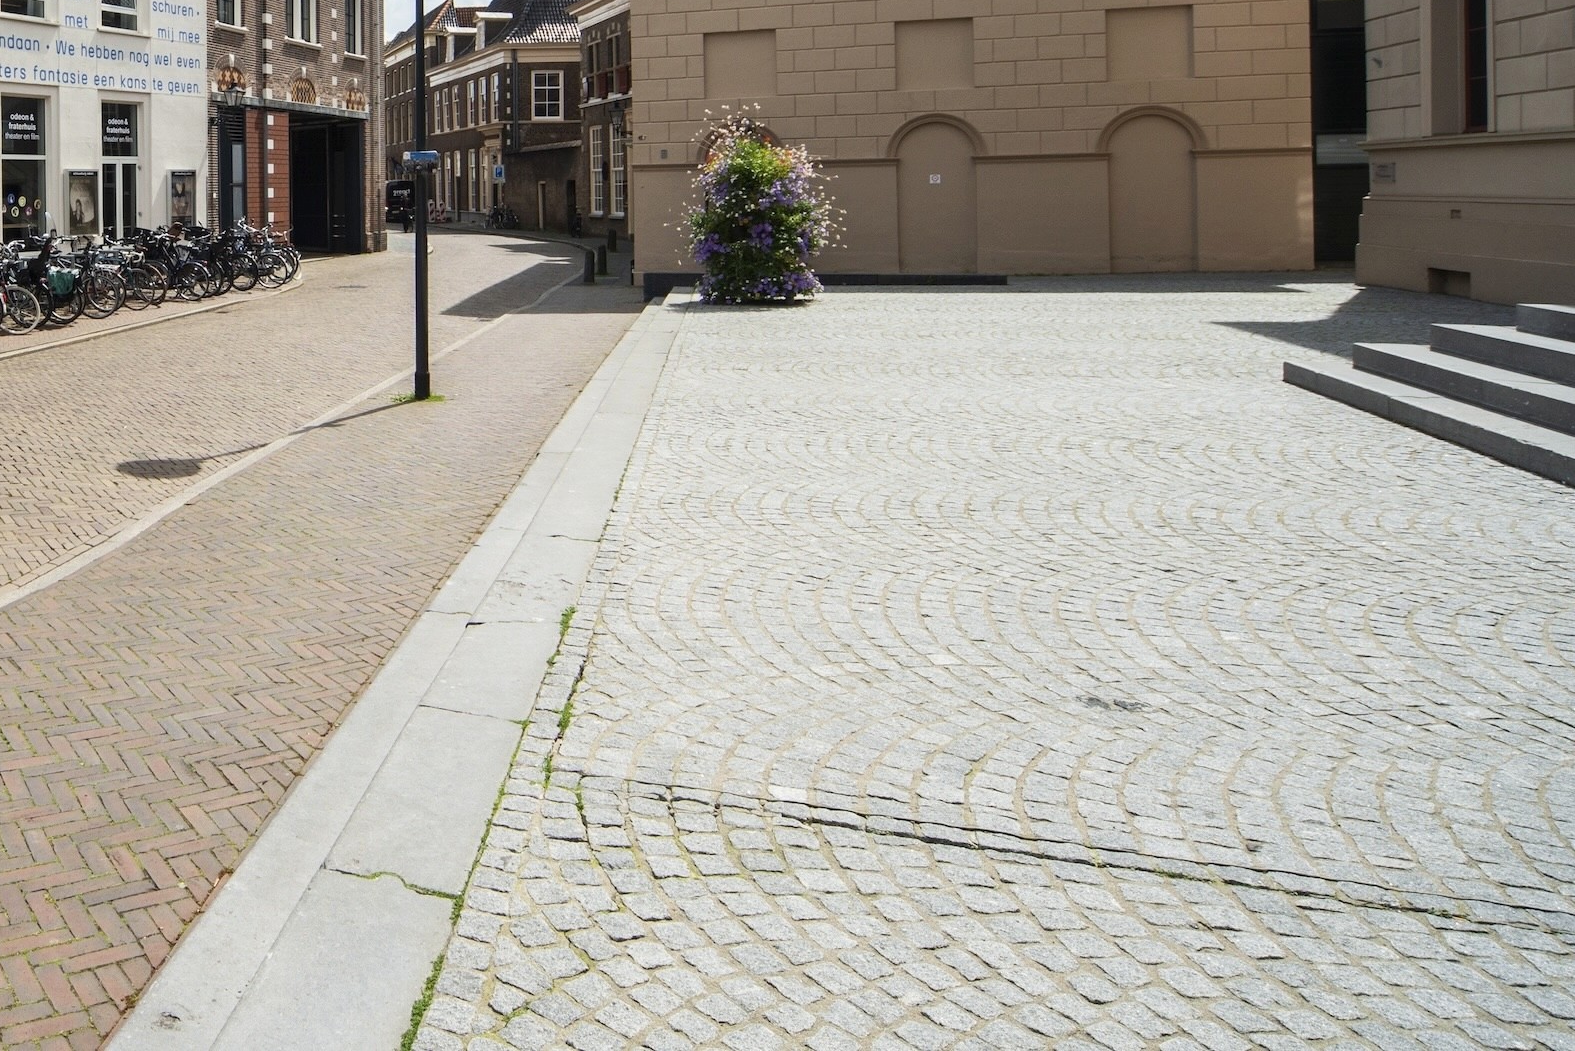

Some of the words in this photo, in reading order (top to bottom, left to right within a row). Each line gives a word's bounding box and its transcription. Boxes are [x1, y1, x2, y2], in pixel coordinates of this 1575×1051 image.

[152, 0, 193, 17] schuren
[65, 15, 87, 28] met
[158, 27, 174, 43] mij
[179, 31, 200, 43] mee
[56, 40, 75, 56] We
[81, 44, 123, 60] hebben
[130, 52, 149, 67] nog
[154, 54, 171, 66] wel
[177, 57, 200, 68] even
[33, 65, 88, 85] fantasie
[94, 75, 114, 86] een
[121, 75, 146, 89] kans
[153, 79, 163, 91] te
